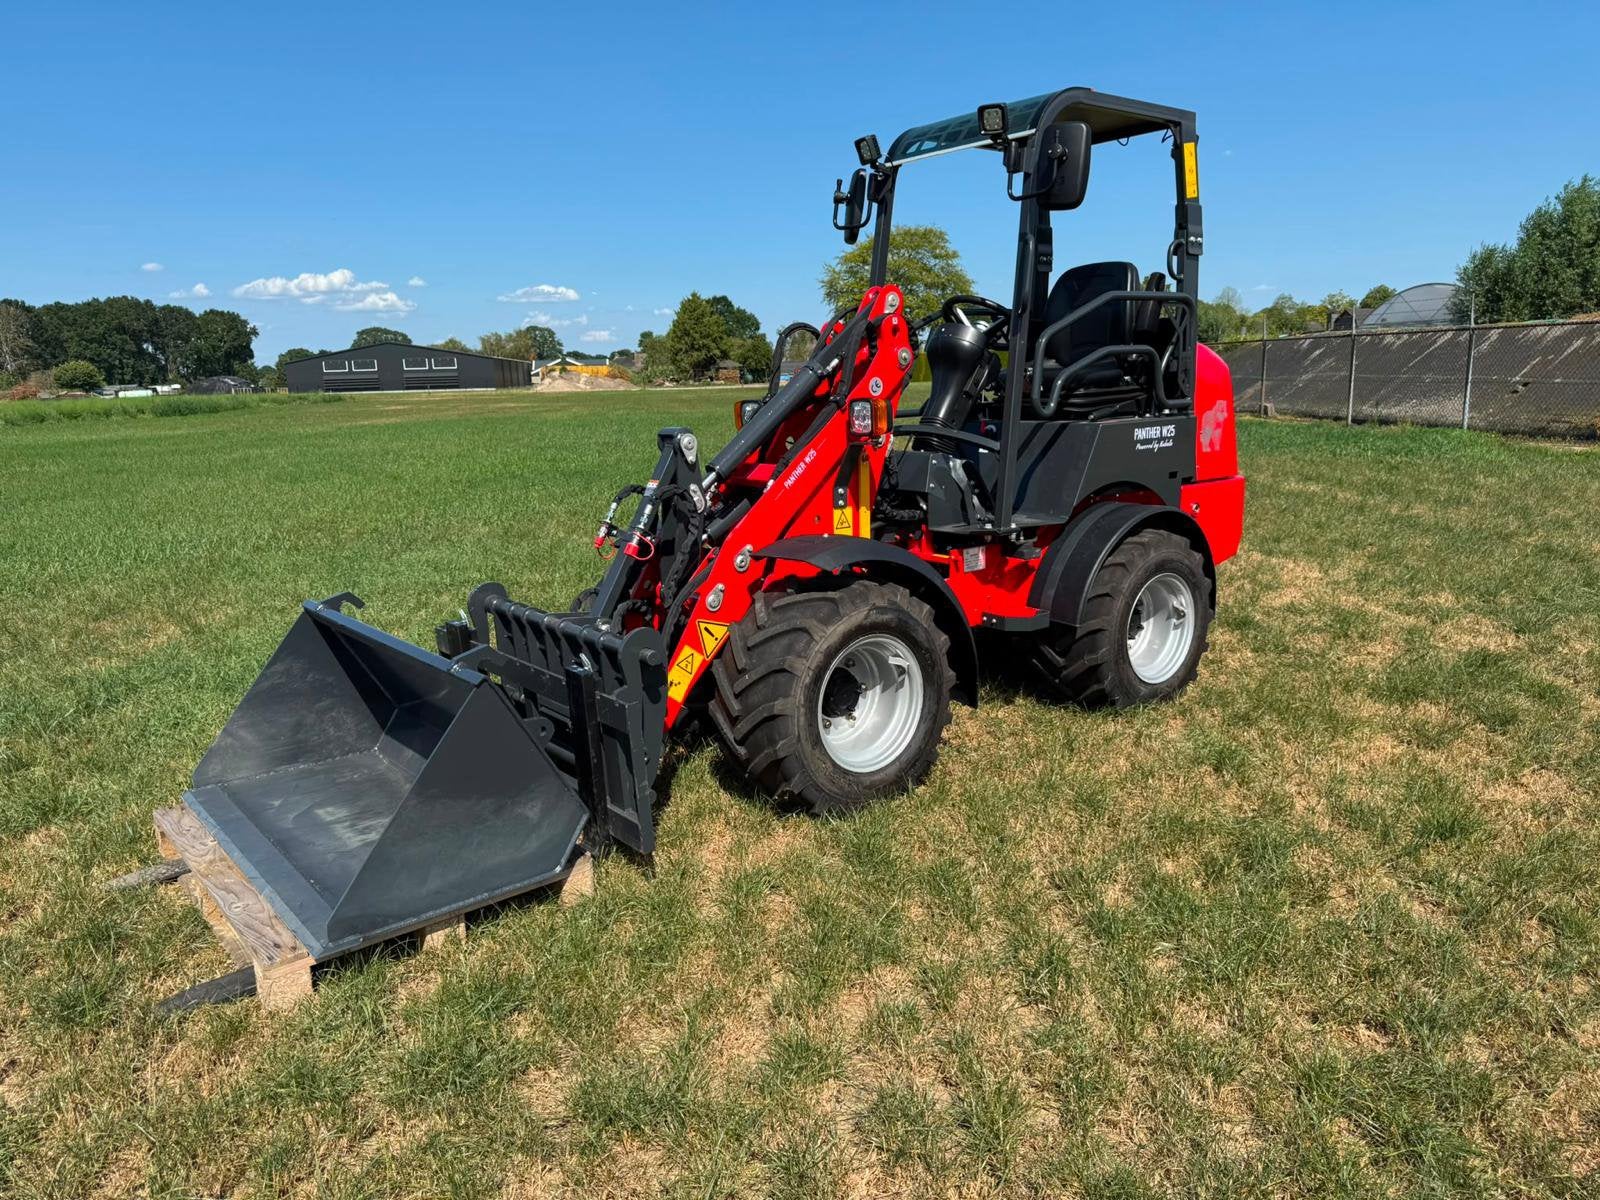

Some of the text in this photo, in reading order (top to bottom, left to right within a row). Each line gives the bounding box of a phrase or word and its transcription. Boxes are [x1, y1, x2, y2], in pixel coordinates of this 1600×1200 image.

[1134, 424, 1175, 440] PANTHER W25
[784, 461, 806, 489] PANTHER
